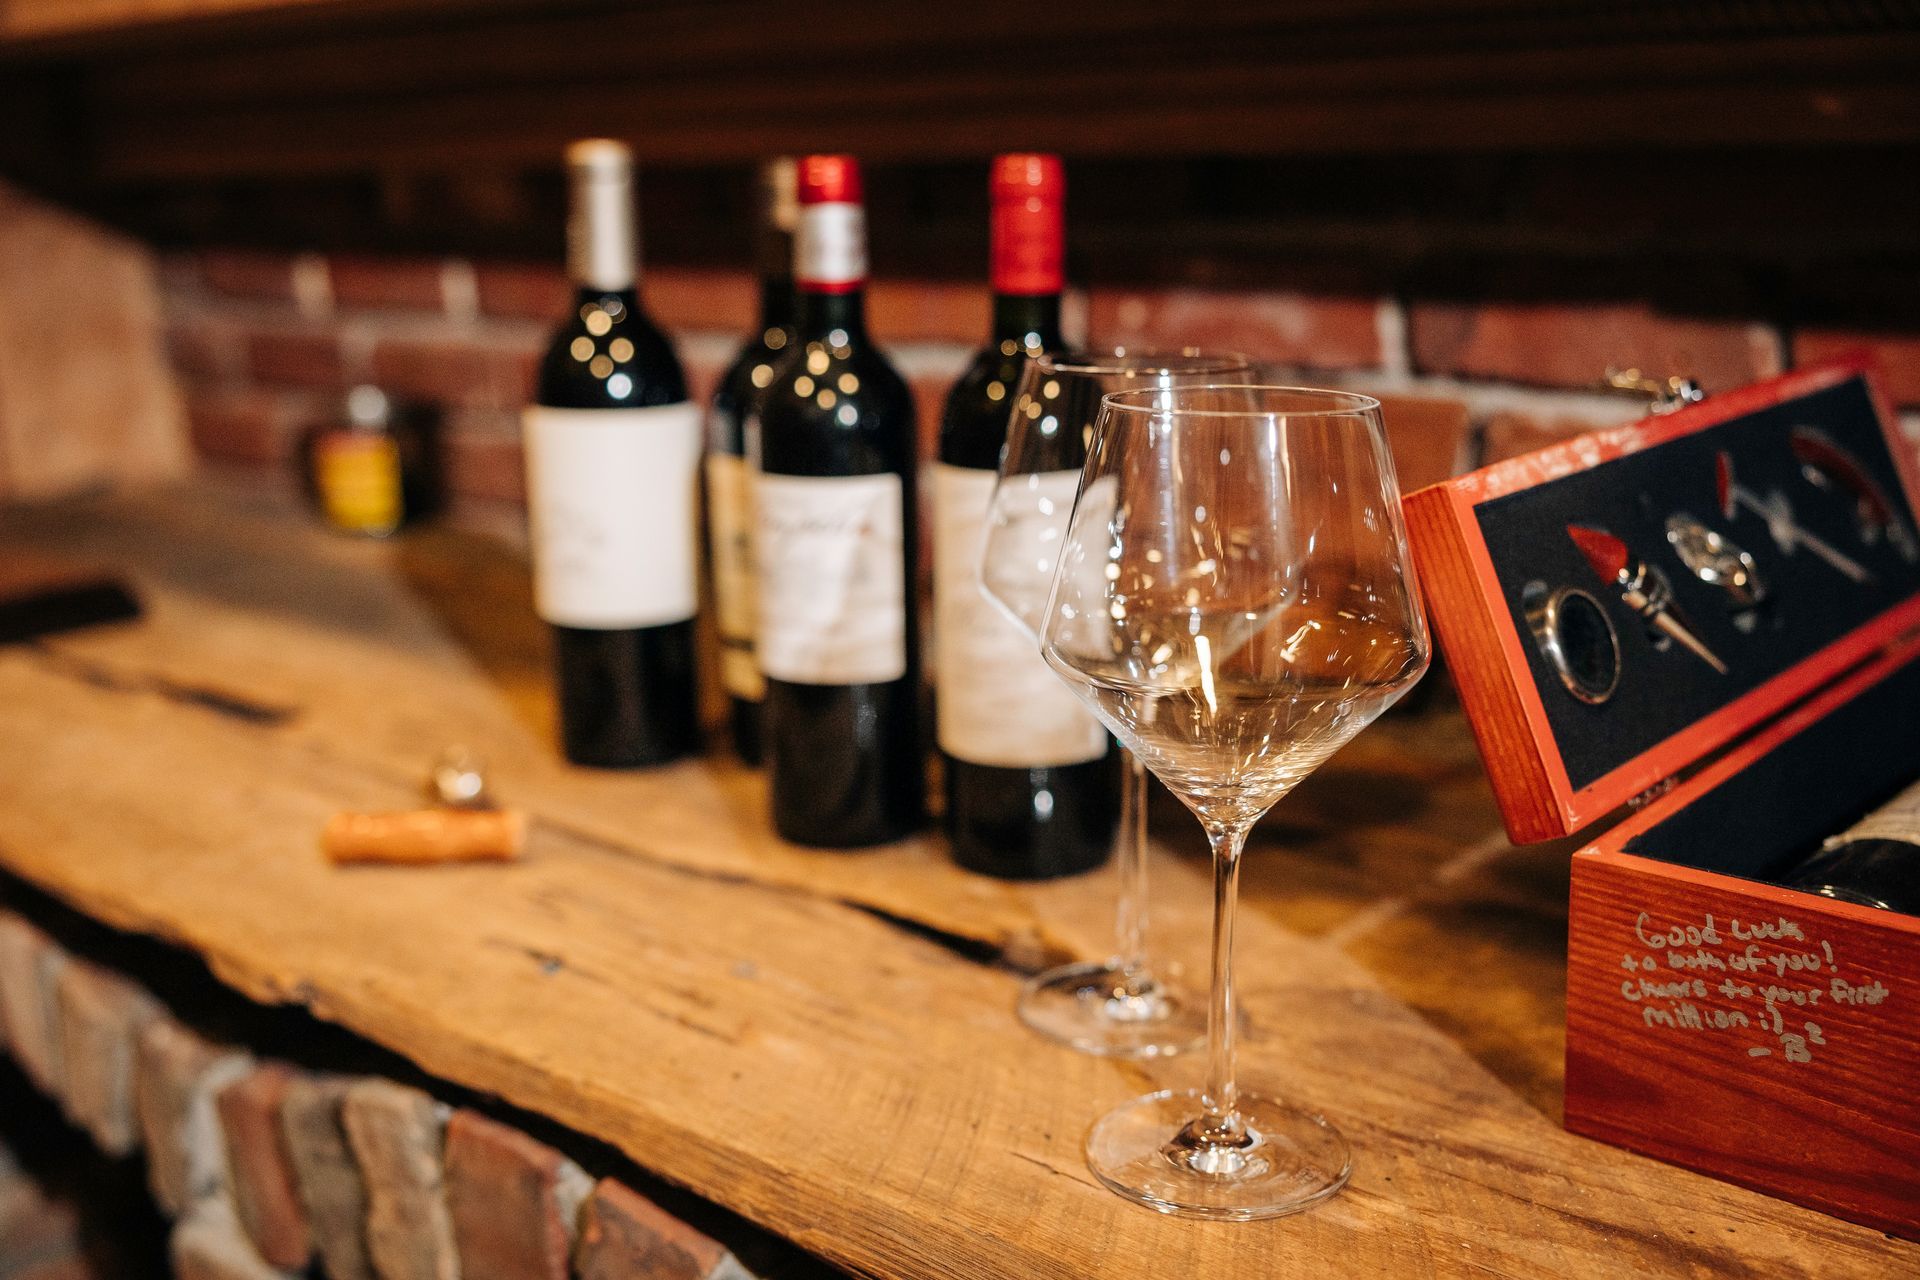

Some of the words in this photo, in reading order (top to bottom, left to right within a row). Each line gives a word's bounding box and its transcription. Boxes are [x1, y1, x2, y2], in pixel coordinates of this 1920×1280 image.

[1636, 912, 1723, 948] Good
[1621, 954, 1656, 972] to
[1668, 950, 1725, 971] both
[1729, 944, 1767, 972] of
[1719, 978, 1753, 999] to
[1759, 985, 1822, 1007] your
